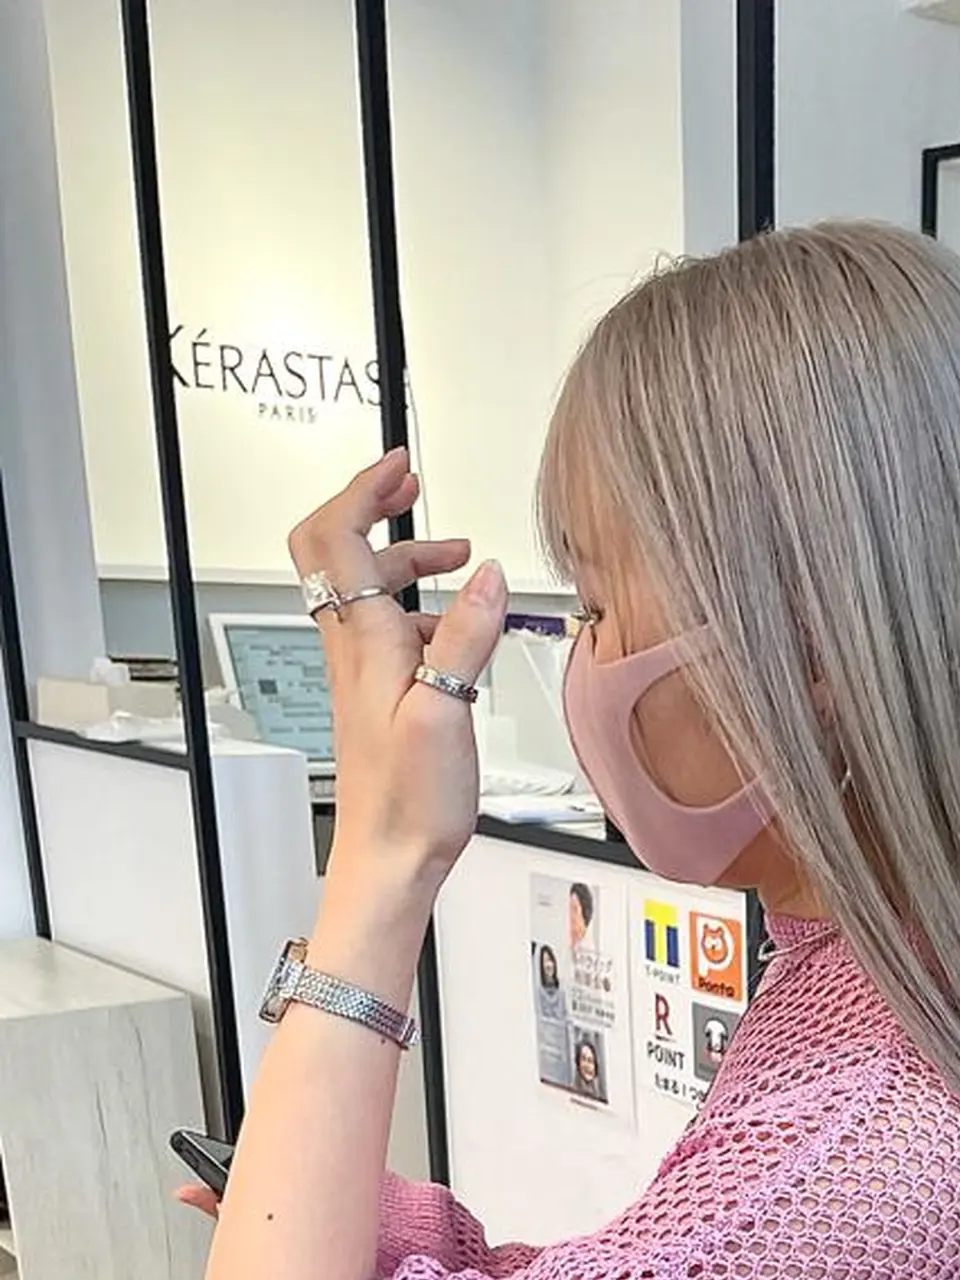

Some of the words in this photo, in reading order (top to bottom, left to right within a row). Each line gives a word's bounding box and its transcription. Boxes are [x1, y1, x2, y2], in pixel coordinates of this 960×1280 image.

[168, 324, 409, 407] KÉRASTAS
[258, 403, 317, 424] PARIS
[698, 976, 736, 998] Ponta
[646, 1041, 686, 1070] POINT
